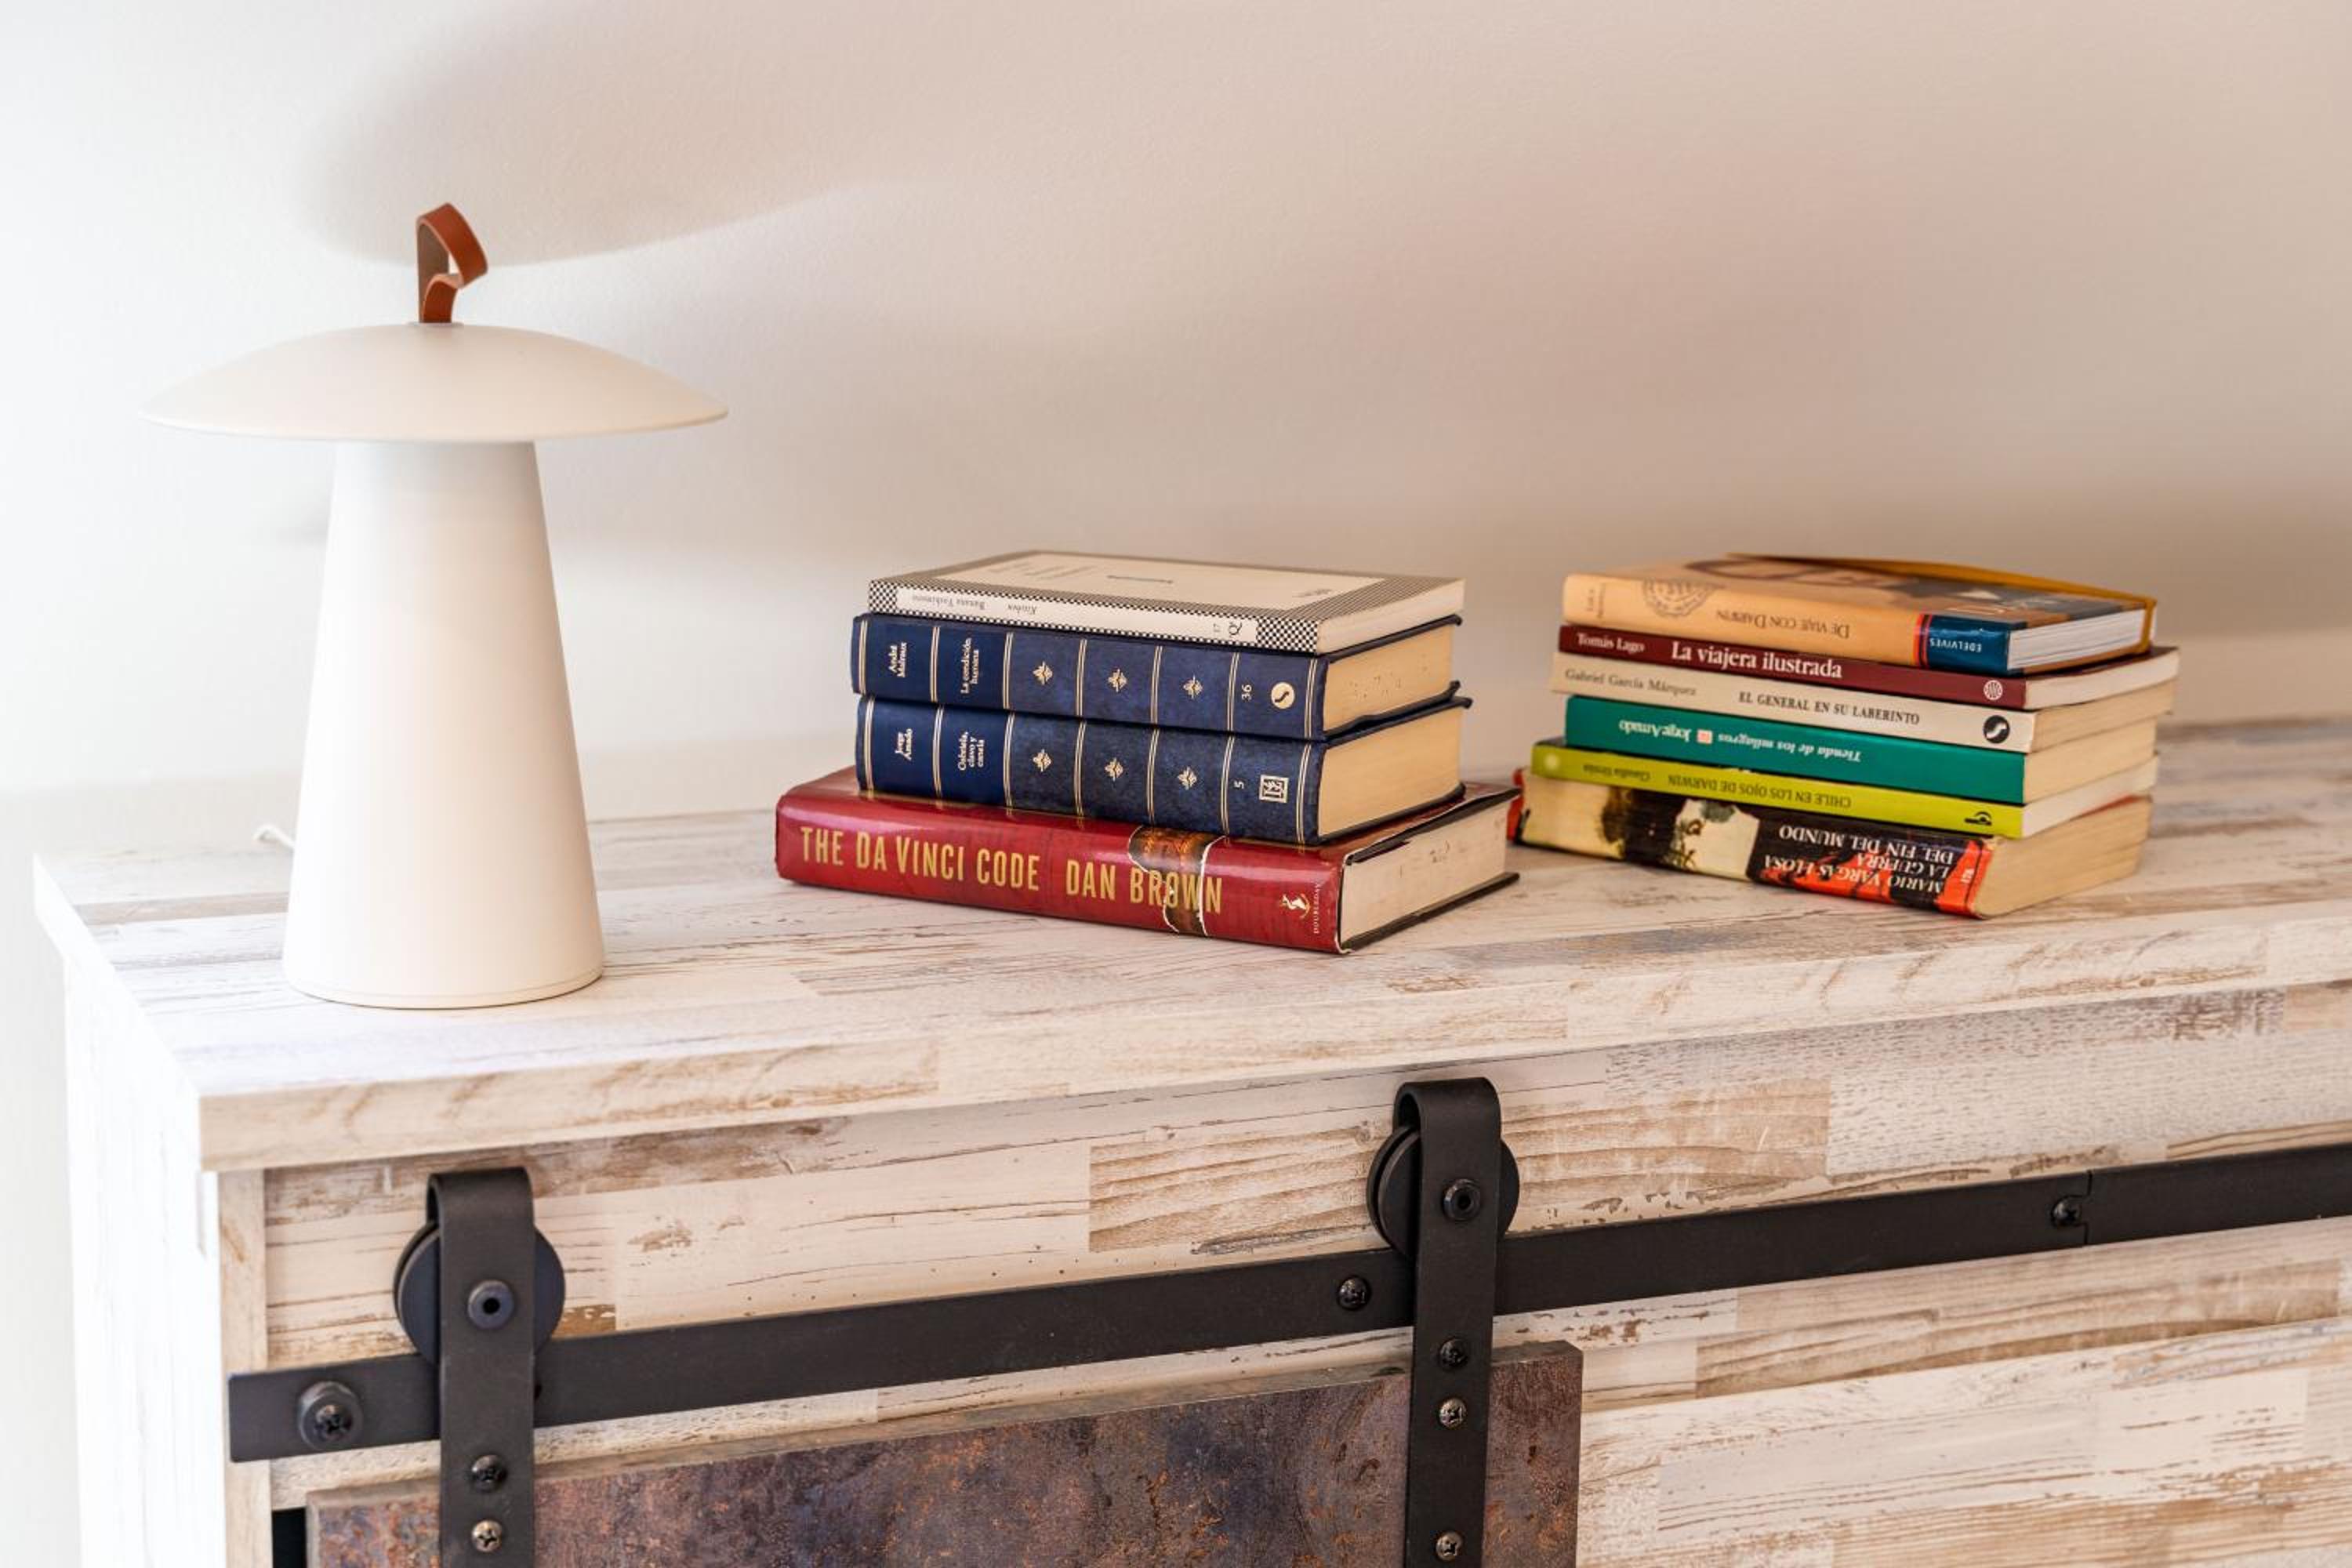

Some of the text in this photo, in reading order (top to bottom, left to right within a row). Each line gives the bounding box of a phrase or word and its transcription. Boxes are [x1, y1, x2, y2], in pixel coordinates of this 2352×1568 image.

[1576, 632, 1646, 654] Tomás Lago
[1929, 637, 1983, 653] EDELVIVES
[888, 644, 898, 673] André
[897, 641, 907, 678] Malraux
[960, 637, 972, 694] La condición
[969, 649, 979, 684] humana
[1671, 641, 1842, 678] La viajera ilustrada
[1241, 684, 1253, 702] 36
[1566, 668, 1697, 698] Gabriel García Márquez
[1739, 691, 1920, 726] EL GENERAL EN SU LABERINTO
[967, 744, 976, 768] clavo
[977, 739, 985, 768] canela
[1718, 732, 1862, 763] Tienda de los milagros
[1234, 780, 1245, 789] 5
[1668, 774, 1852, 809] CHILE EN LOS OJOS DE DARWIN
[800, 826, 1041, 891] THE DA VINCI CODE
[1779, 824, 1954, 865] DEL FIN DEL MUNDO
[1819, 863, 1880, 887] VARGAS
[1857, 852, 1925, 874] GUERRA
[1928, 866, 1951, 880] LA
[1065, 859, 1223, 915] DAN BROWN
[1887, 876, 1944, 894] MARIO
